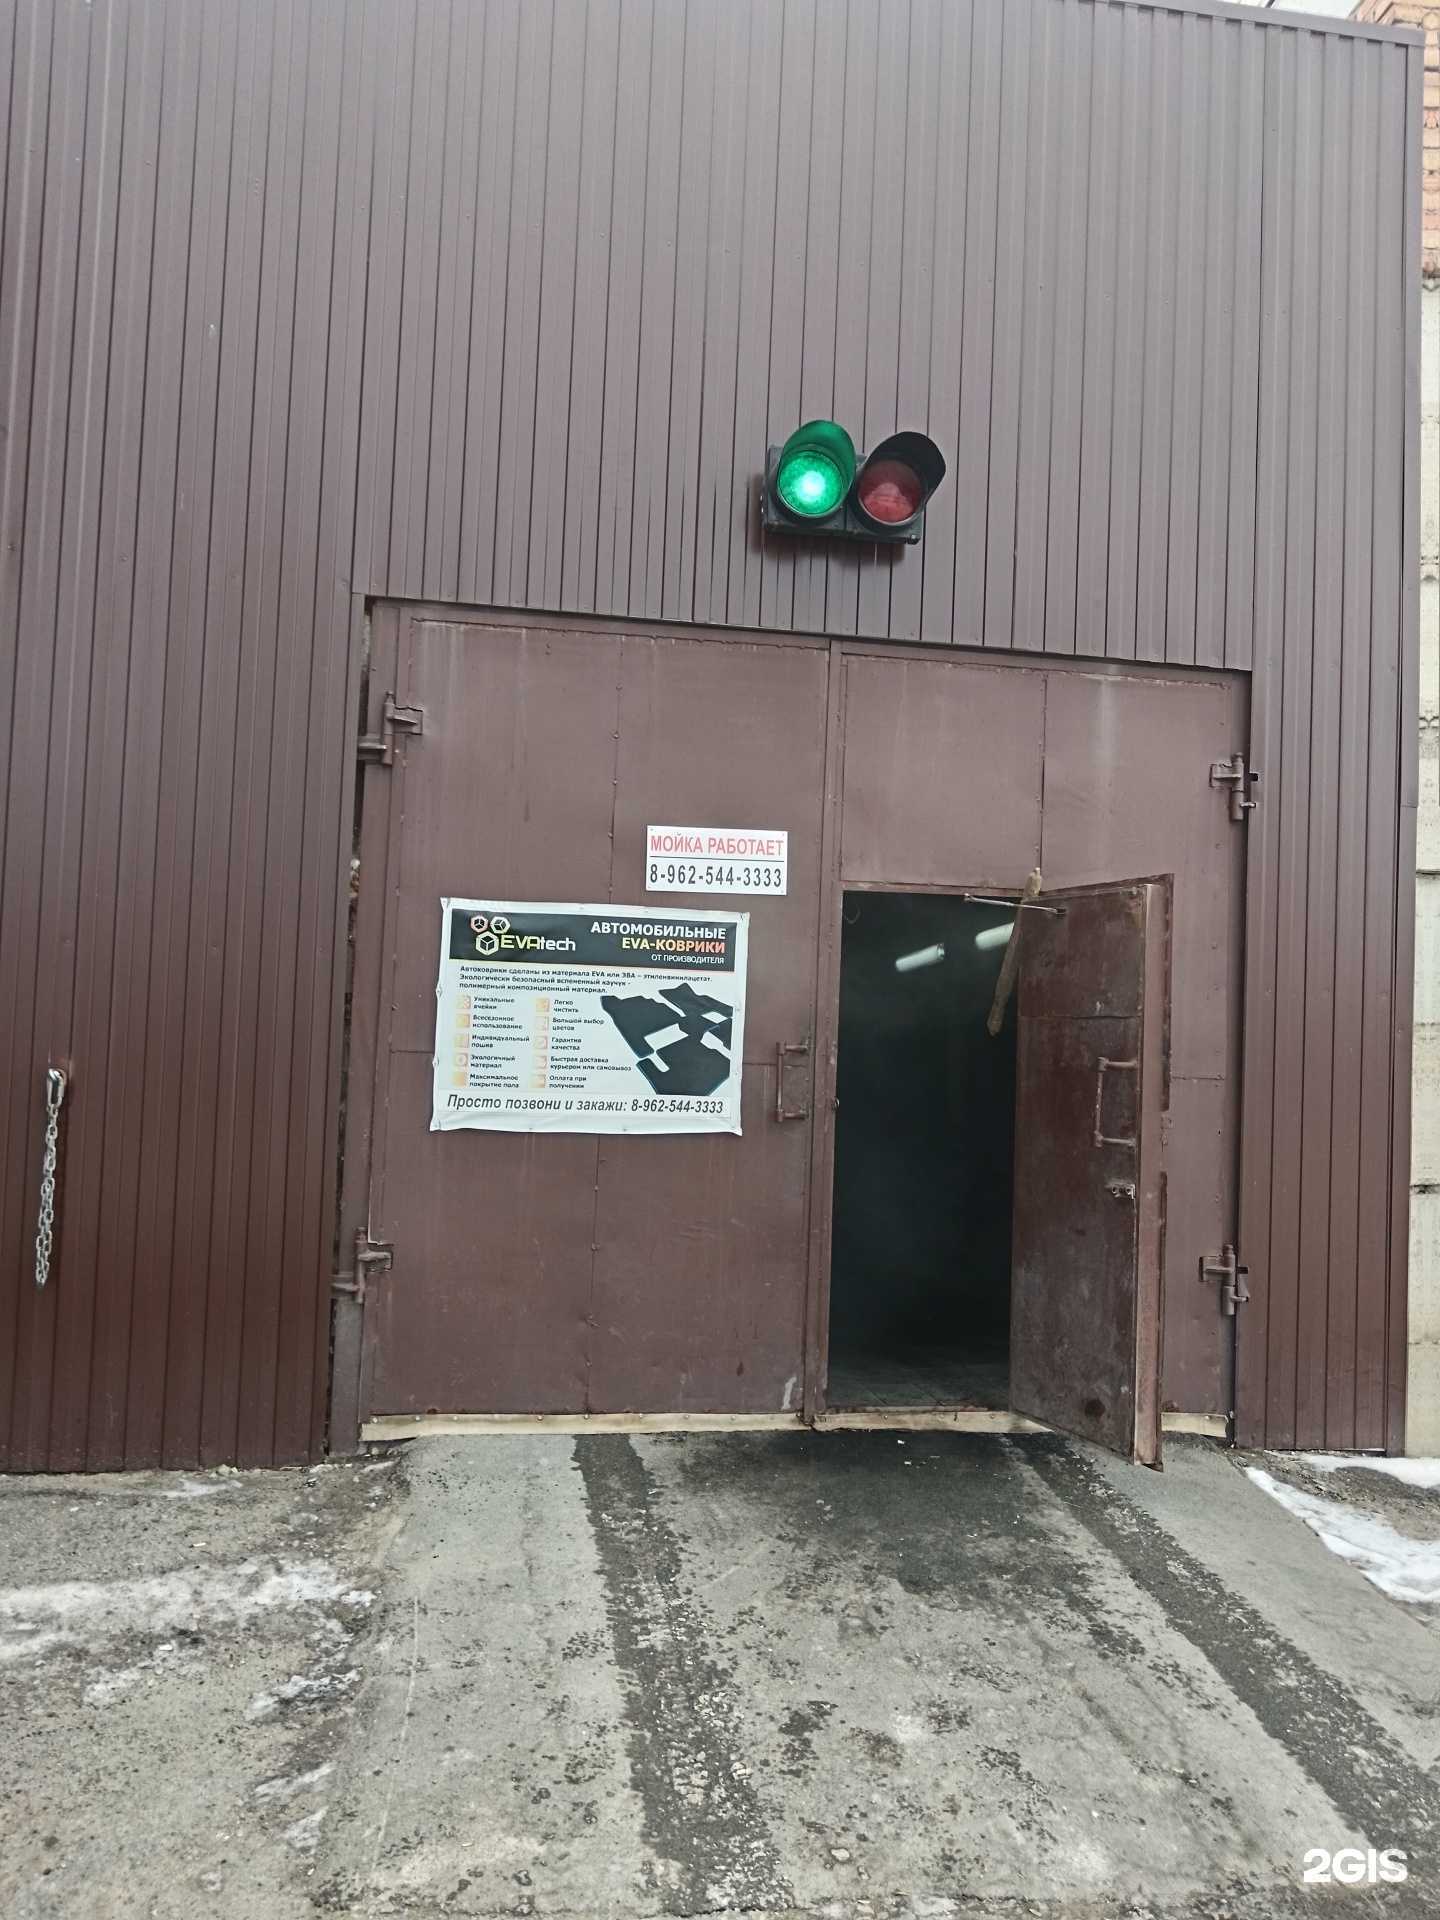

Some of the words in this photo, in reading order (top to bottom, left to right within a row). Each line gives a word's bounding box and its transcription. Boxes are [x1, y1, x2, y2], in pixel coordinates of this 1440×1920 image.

[651, 832, 703, 853] МОЙКА
[708, 838, 784, 856] РАБОТАЕТ
[650, 864, 782, 887] 8-962-544-3333
[591, 922, 726, 939] АВТОМОБИЛЬНЫЕ
[500, 935, 576, 951] EVAtech
[622, 937, 725, 953] EVA-КОВРИКИ
[663, 954, 725, 964] ПРОИЗВОДИТЕЛЯ
[460, 966, 507, 974] Автоковрики
[460, 973, 510, 981] Экологически
[459, 982, 506, 990] полимерный
[472, 1022, 523, 1030] использование
[471, 1034, 530, 1042] Индивидуальный
[470, 1054, 516, 1062] Экологичный
[469, 1073, 519, 1081] Максимальное
[447, 1094, 501, 1110] Просто
[505, 1098, 561, 1111] позвони
[564, 1099, 573, 1109] и
[576, 1101, 627, 1111] закажи:
[631, 1098, 723, 1113] 8-962-544-3333
